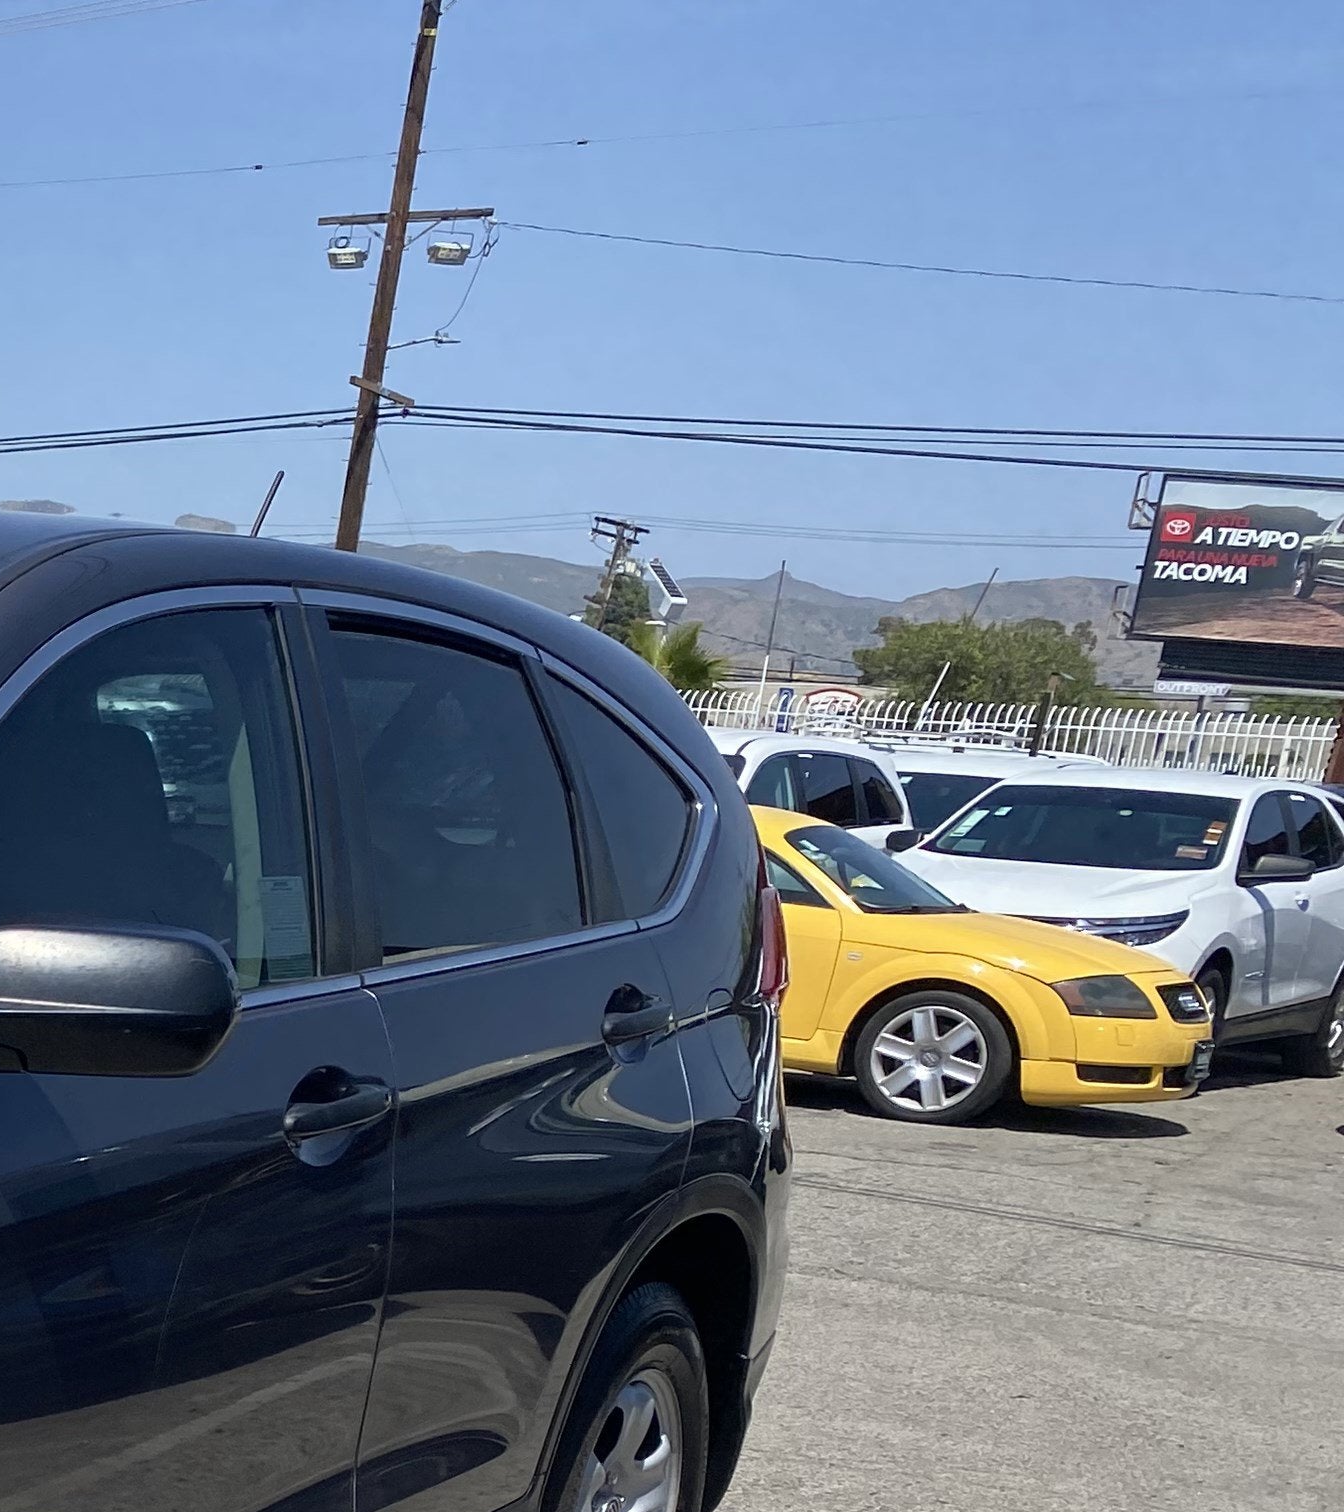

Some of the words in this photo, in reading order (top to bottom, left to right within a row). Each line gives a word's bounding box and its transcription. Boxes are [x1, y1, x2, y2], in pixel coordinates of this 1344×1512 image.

[1193, 526, 1213, 545] A
[1217, 527, 1299, 550] TIEMPO
[1158, 548, 1198, 562] PARA
[1198, 550, 1232, 564] UNA
[1232, 552, 1278, 567] NUEVA
[1153, 561, 1248, 584] TACOMA
